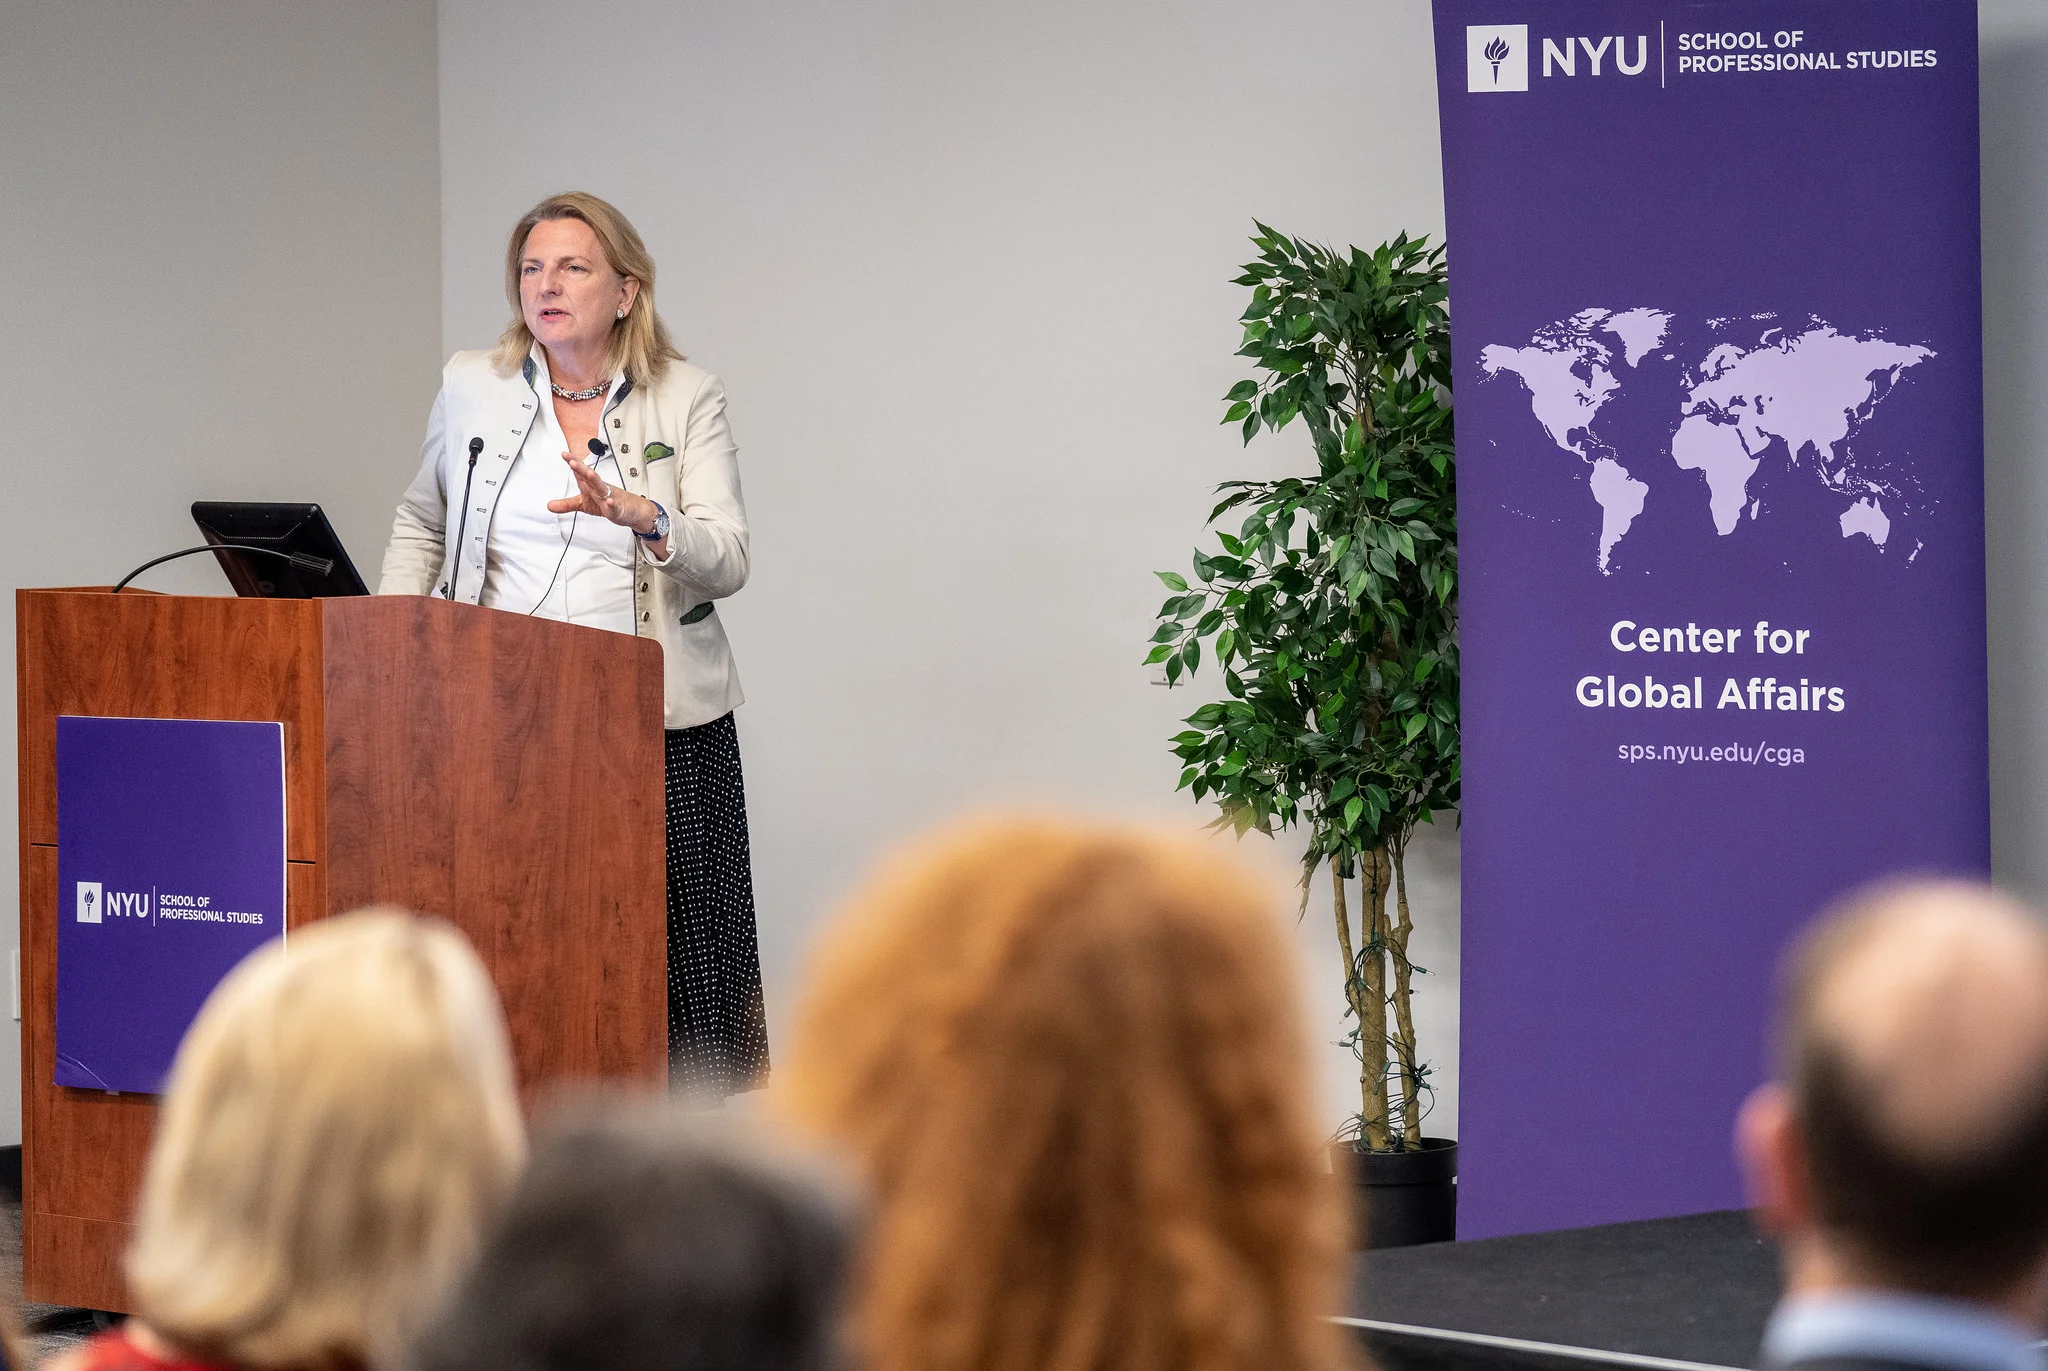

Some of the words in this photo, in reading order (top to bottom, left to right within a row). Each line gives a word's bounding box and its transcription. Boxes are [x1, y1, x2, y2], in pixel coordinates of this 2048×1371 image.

[1679, 32, 1768, 51] SCHOOL
[1774, 31, 1804, 49] OF
[1543, 36, 1647, 77] NYU
[1679, 53, 1842, 73] PROFESSIONAL
[1847, 50, 1938, 69] STUDIES
[1610, 620, 1742, 654] Center
[1753, 620, 1810, 655] for
[1576, 675, 1704, 709] Global
[1717, 677, 1845, 712] Affairs
[1618, 741, 1805, 767] sps.nyu.edu/cga
[106, 891, 149, 918] NYU
[159, 894, 196, 907] SCHOOL
[197, 896, 210, 908] OF
[159, 908, 226, 923] PROFESSIONAL
[226, 911, 264, 925] STUDIES
